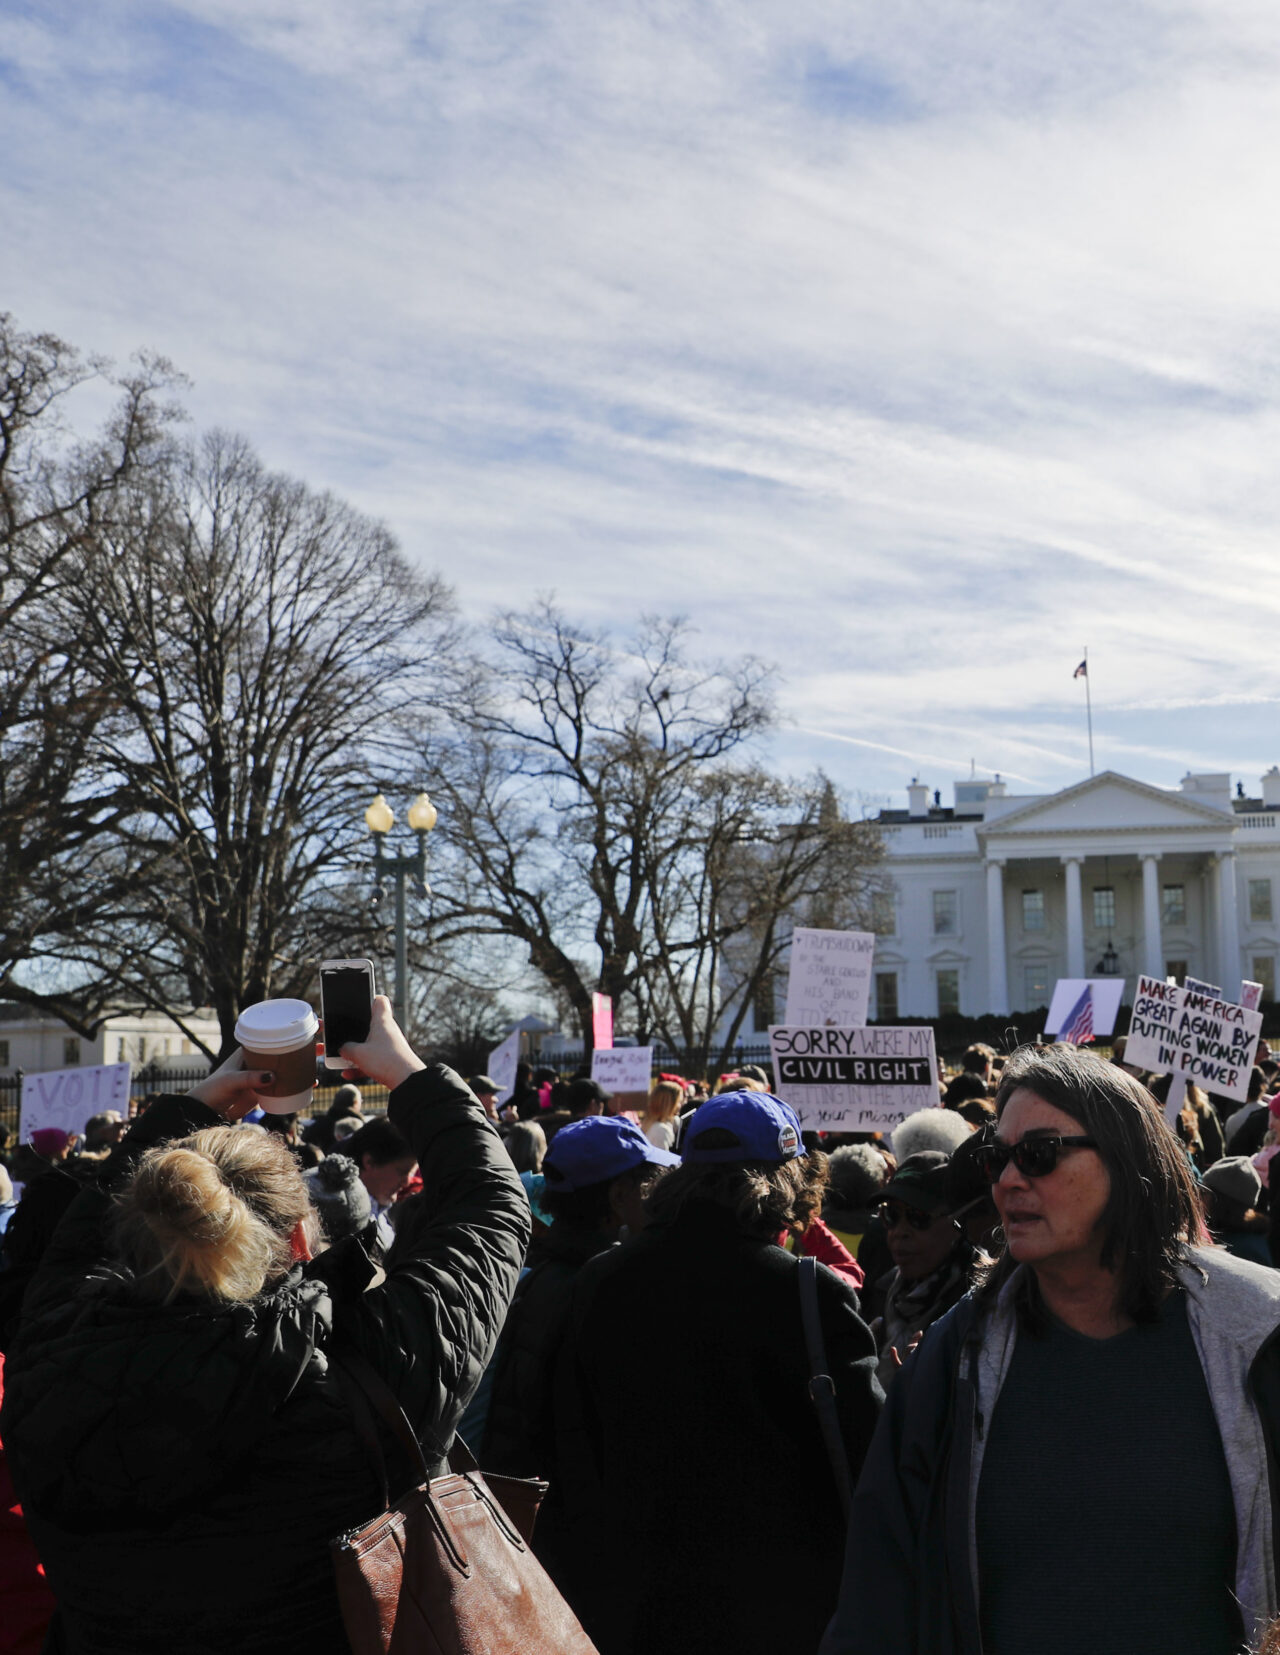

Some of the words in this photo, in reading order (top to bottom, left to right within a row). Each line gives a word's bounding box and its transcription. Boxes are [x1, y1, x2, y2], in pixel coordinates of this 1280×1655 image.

[803, 986, 825, 999] HIS
[822, 977, 842, 987] AND
[1139, 978, 1178, 1004] MAKE
[1183, 992, 1245, 1024] AMERICA
[1135, 998, 1177, 1024] GREAT
[1179, 1012, 1222, 1040] AGAIN
[1232, 1027, 1256, 1049] BY
[772, 1029, 857, 1056] SORRY.
[909, 1029, 933, 1057] MY
[1132, 1017, 1191, 1049] PUTTING
[1196, 1037, 1249, 1067] WOMEN
[782, 1060, 847, 1080] CIVIL
[1158, 1045, 1176, 1066] IN
[1181, 1052, 1239, 1087] POWER
[37, 1066, 126, 1112] VOTE
[848, 1085, 862, 1106] IN
[866, 1085, 897, 1107] THE
[900, 1085, 932, 1107] WAY
[817, 1108, 851, 1127] your
